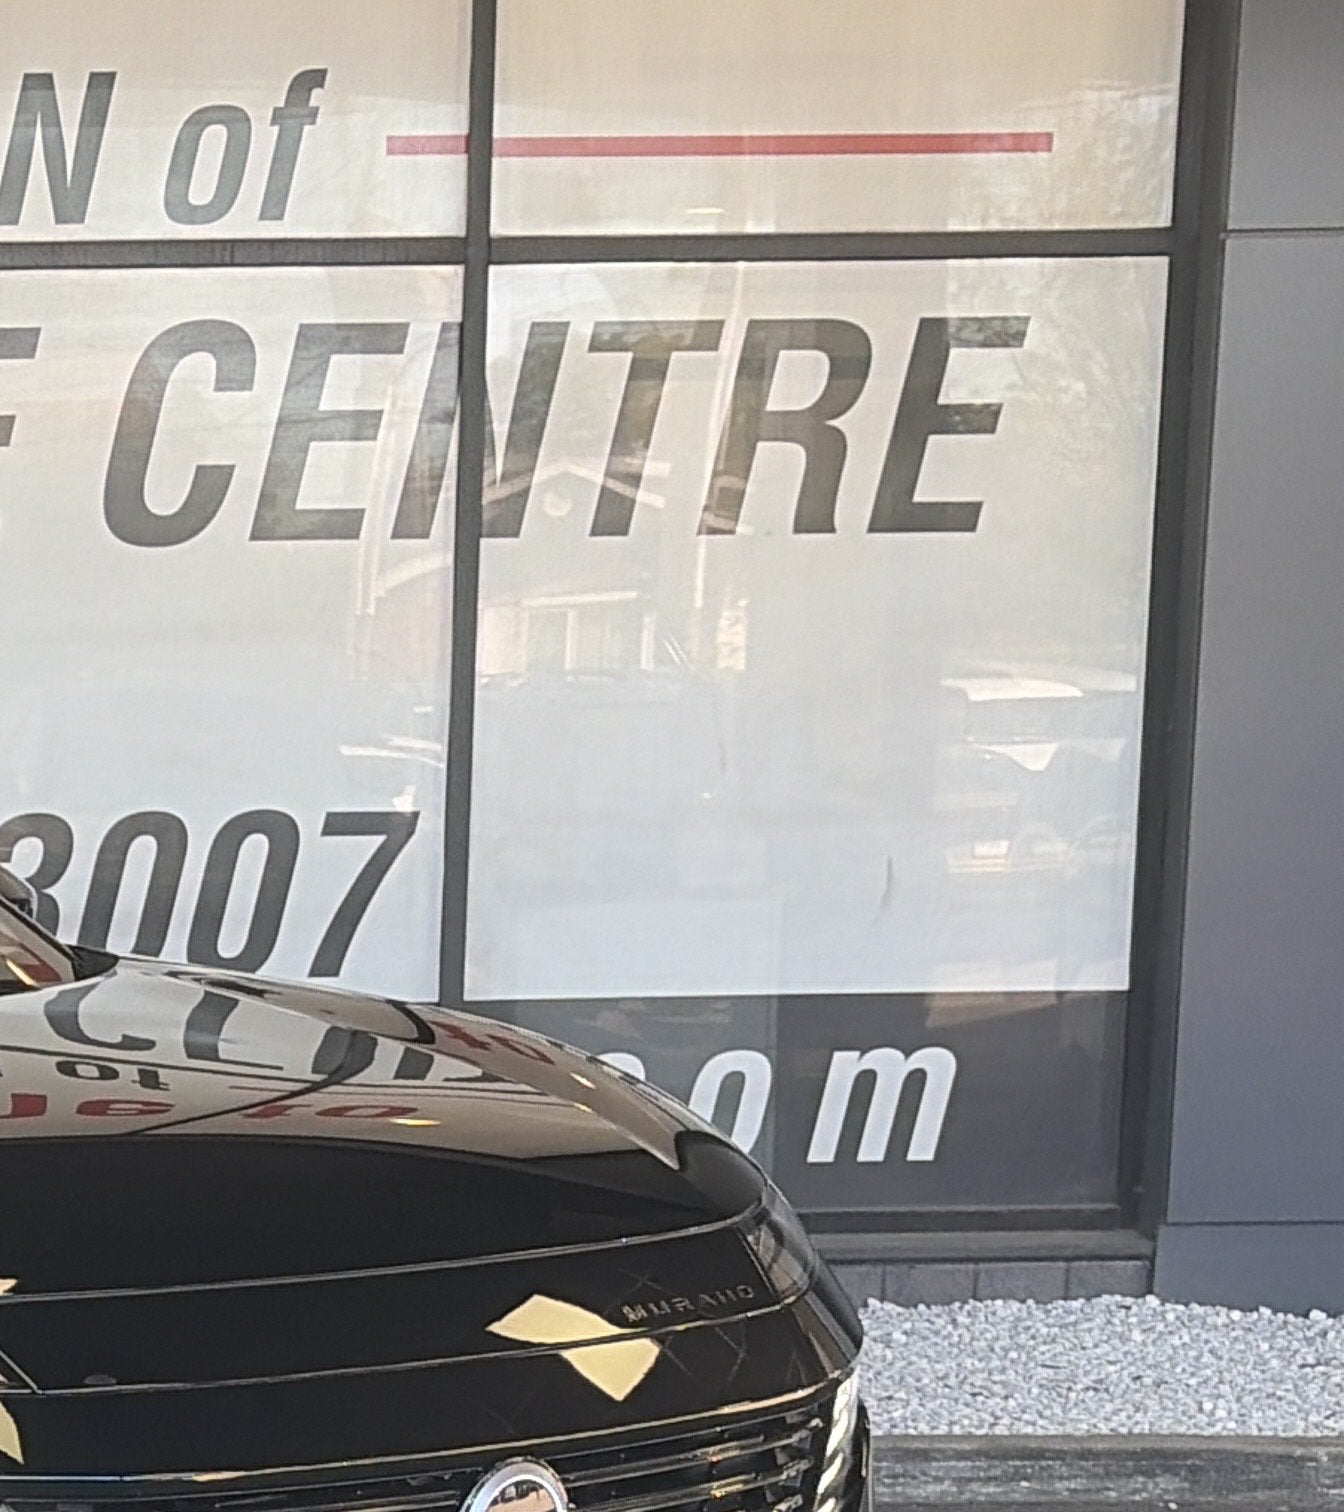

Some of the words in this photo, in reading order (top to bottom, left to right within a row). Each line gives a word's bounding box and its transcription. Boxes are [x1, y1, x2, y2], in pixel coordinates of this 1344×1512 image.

[162, 67, 328, 227] of
[103, 314, 1031, 548] CENTRE
[621, 1284, 755, 1323] MURANO
